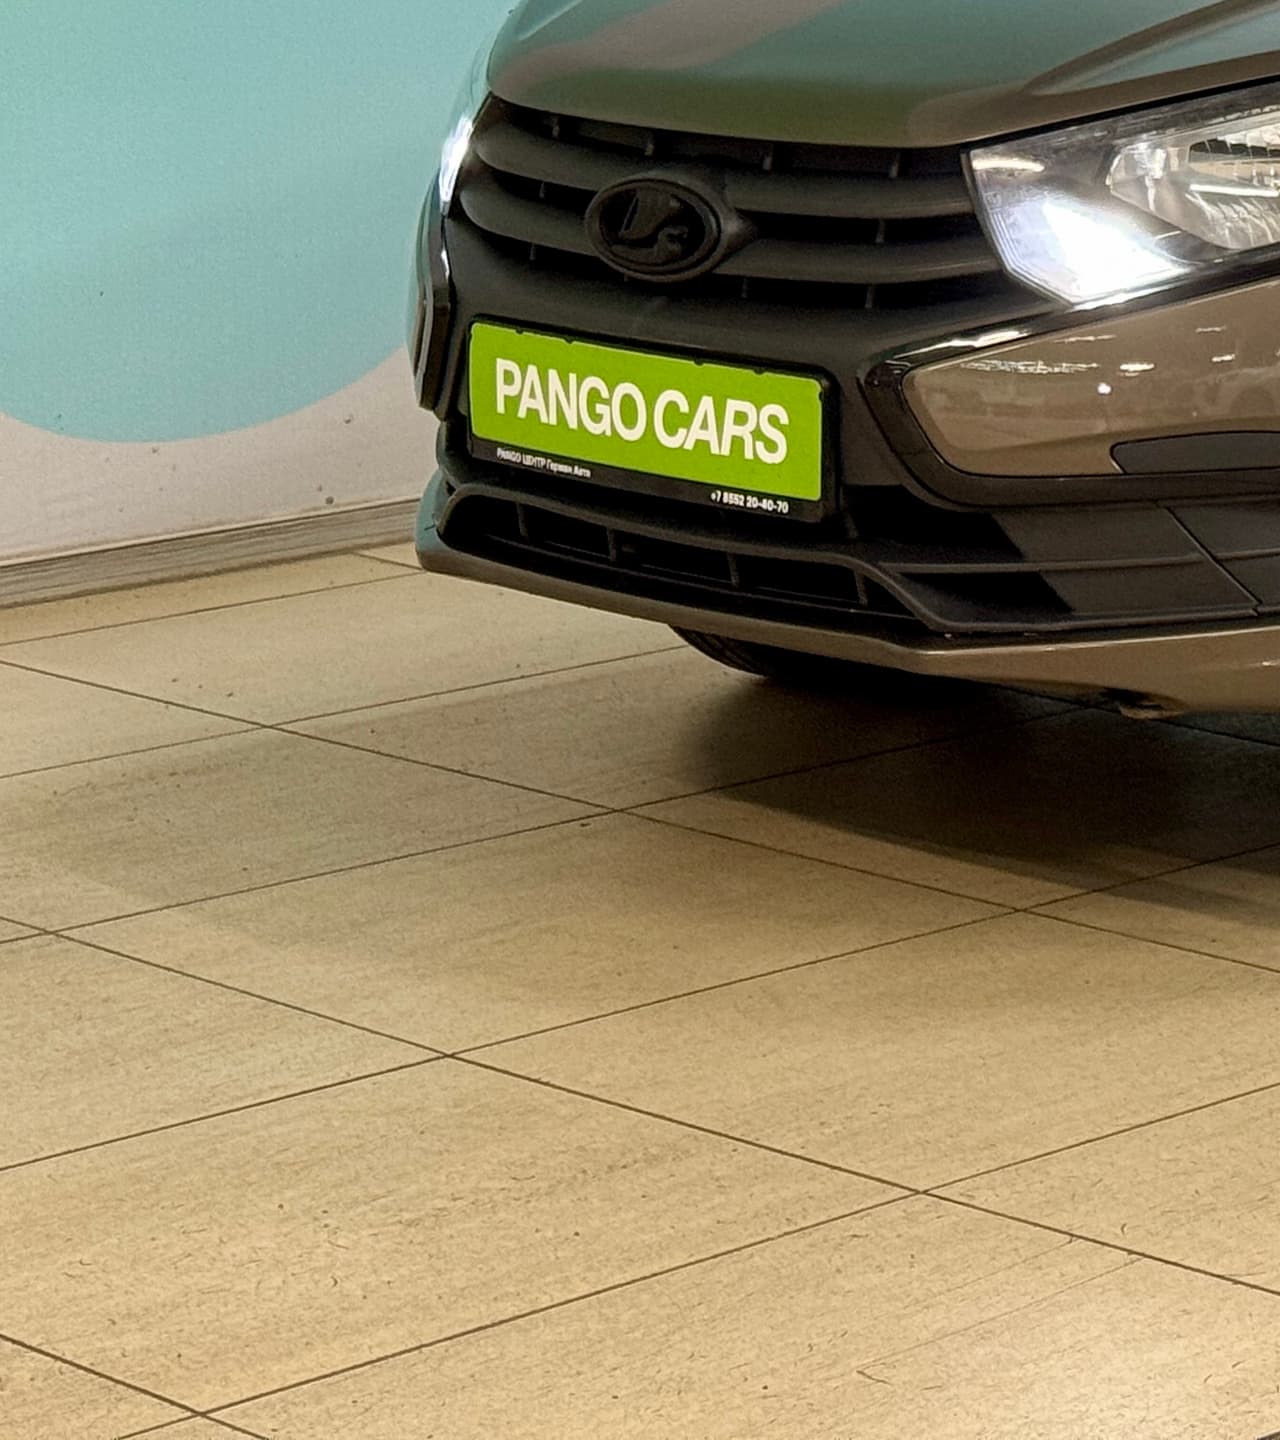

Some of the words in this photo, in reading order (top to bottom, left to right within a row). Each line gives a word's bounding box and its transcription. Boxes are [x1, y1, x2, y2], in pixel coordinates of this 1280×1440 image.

[496, 357, 647, 443] PANGO
[652, 389, 790, 465] CARS
[745, 495, 789, 514] 20-40-70
